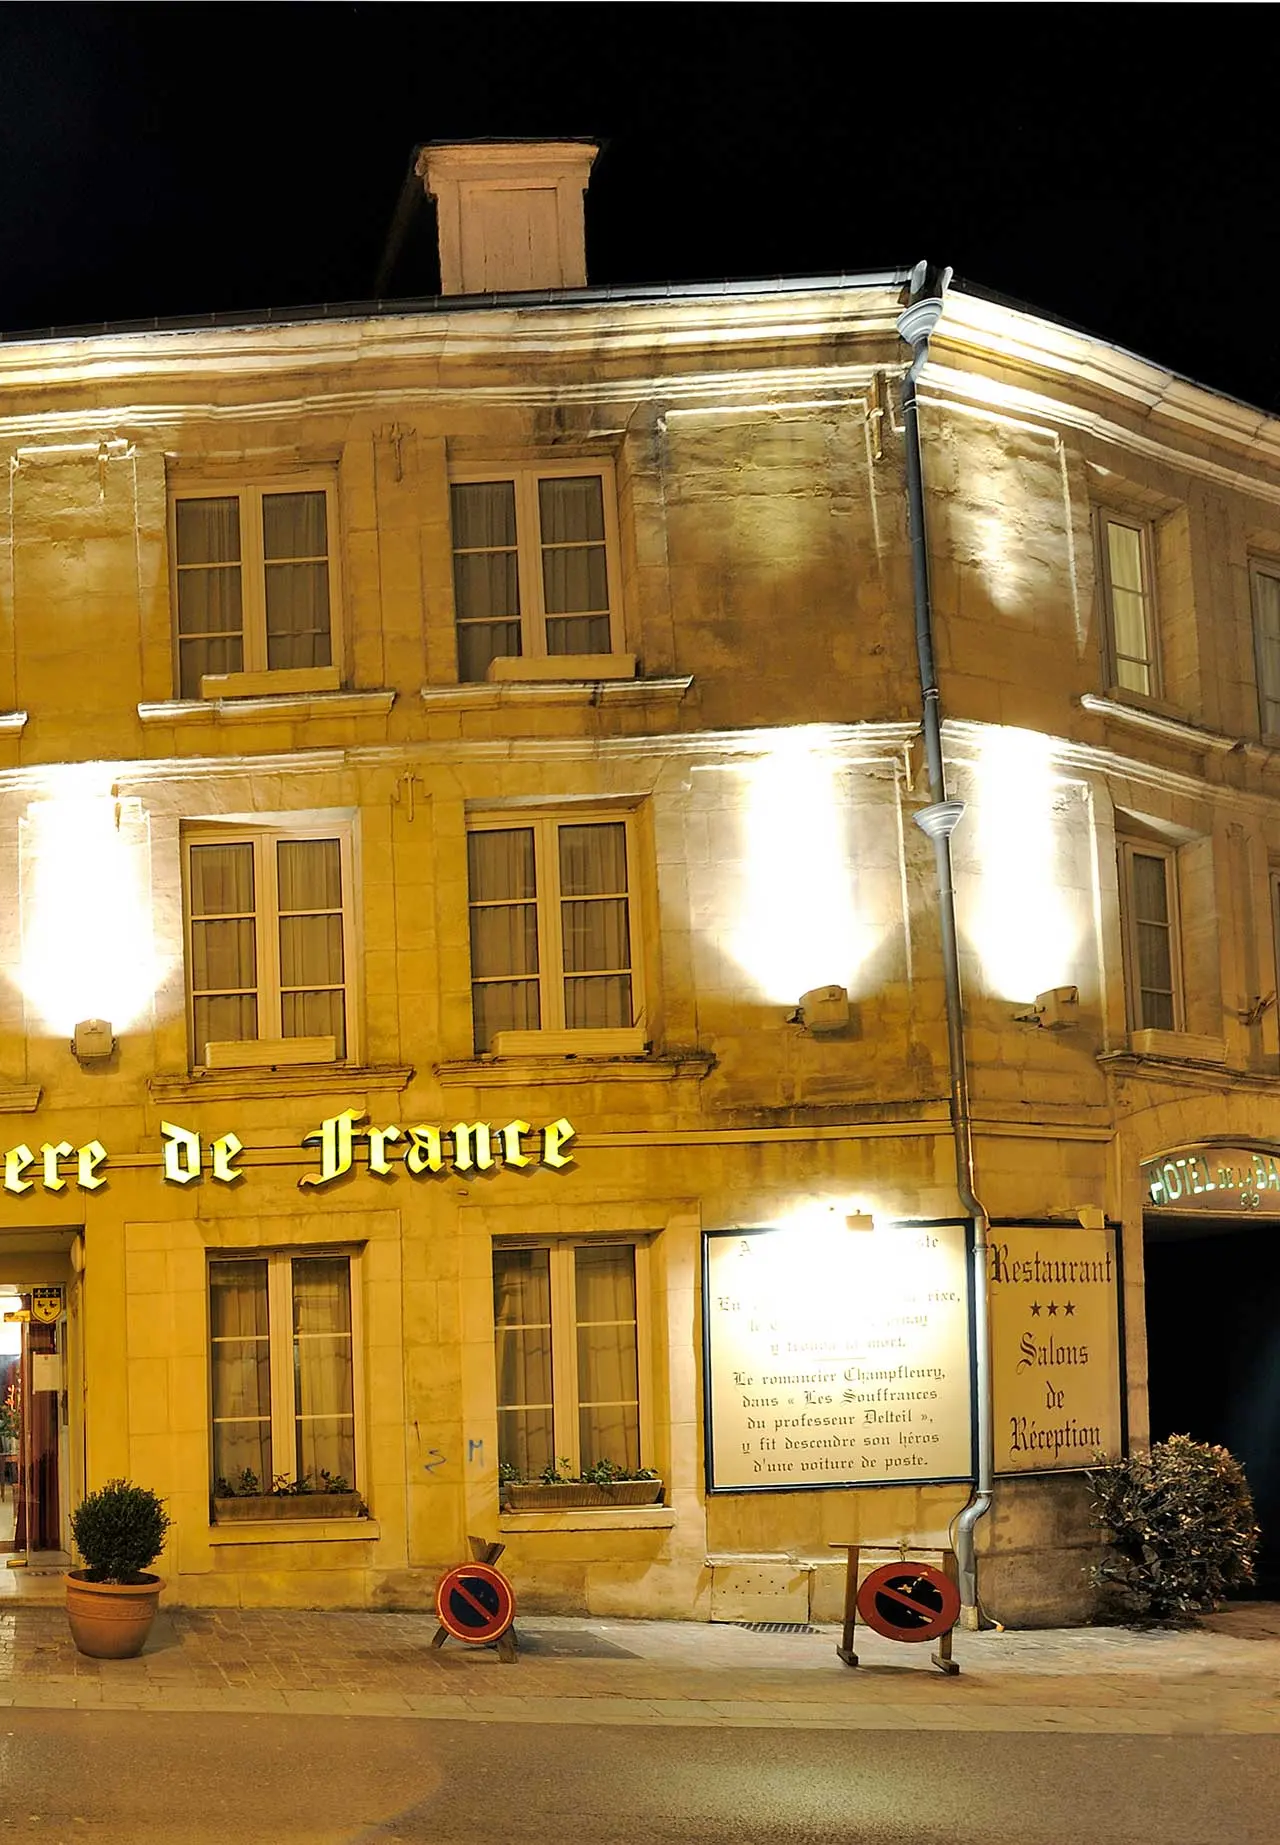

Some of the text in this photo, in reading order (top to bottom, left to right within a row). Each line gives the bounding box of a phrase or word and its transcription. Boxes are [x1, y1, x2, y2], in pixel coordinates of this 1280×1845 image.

[160, 1119, 244, 1186] de
[297, 1107, 578, 1188] France
[991, 1243, 1113, 1284] Restaurant
[1016, 1331, 1089, 1375] Salons
[732, 1366, 945, 1387] Le romancier Champfleury,
[742, 1394, 779, 1408] dans
[804, 1390, 833, 1406] Les
[841, 1388, 938, 1405] Souffrances
[1046, 1380, 1065, 1410] de
[747, 1416, 766, 1430] du
[774, 1413, 856, 1432] professeur
[864, 1409, 912, 1425] Delteil
[742, 1431, 940, 1455] y fit descendre son héros
[1010, 1416, 1101, 1462] Réception
[753, 1454, 929, 1473] d'une voiture de poste.
